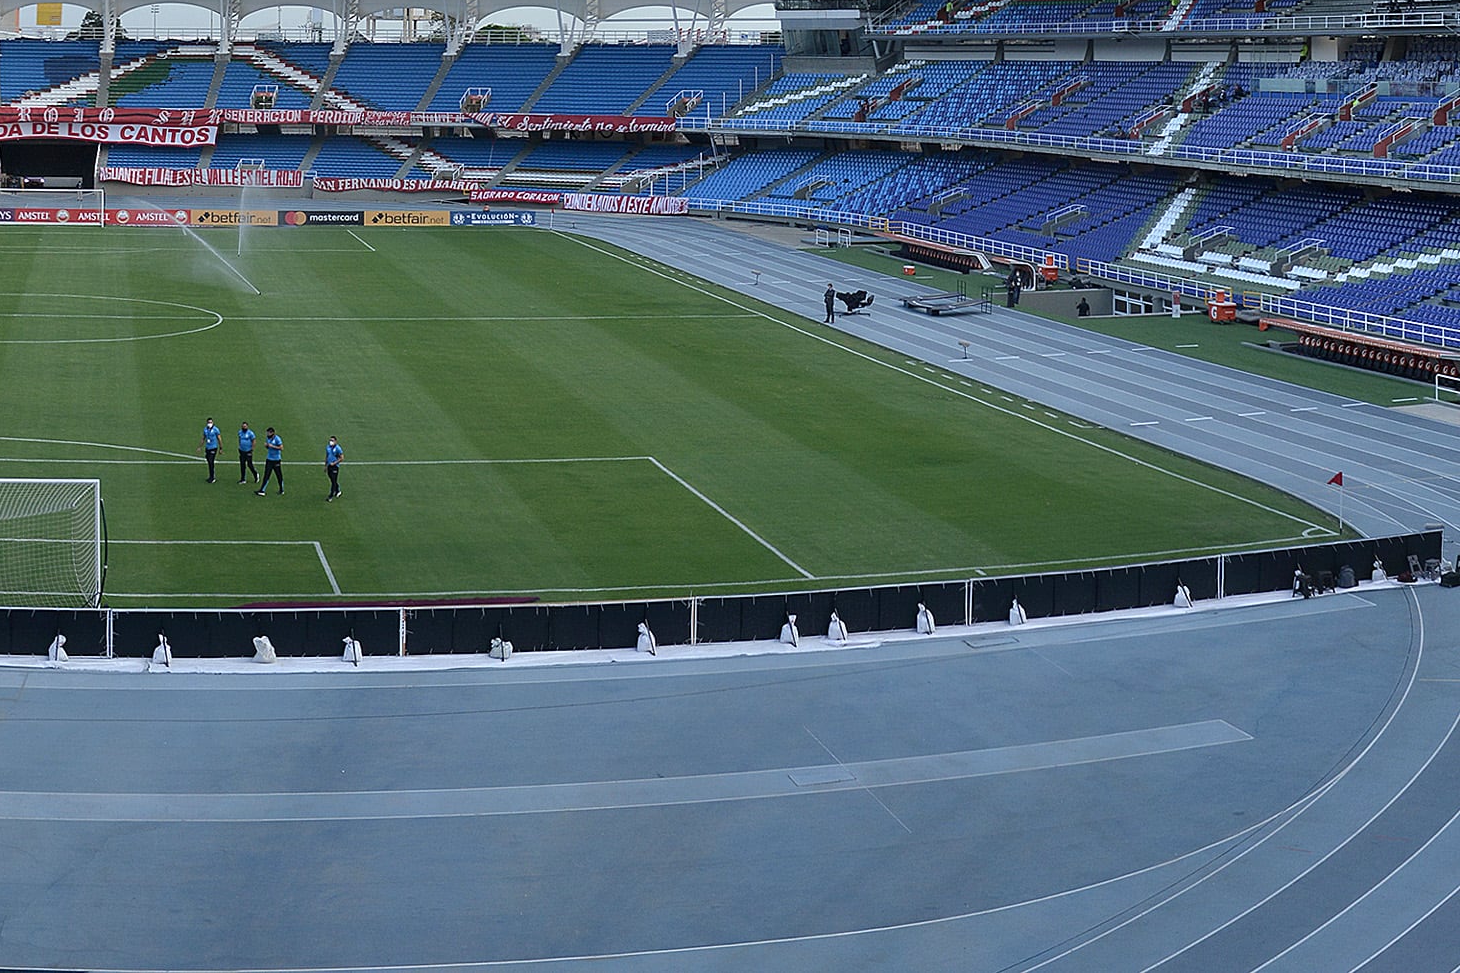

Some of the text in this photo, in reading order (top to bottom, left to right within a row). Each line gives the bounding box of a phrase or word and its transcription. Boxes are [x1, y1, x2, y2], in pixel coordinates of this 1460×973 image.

[152, 109, 223, 125] SUR
[225, 109, 302, 124] GENERACION
[517, 115, 592, 132] Sentimiento
[595, 120, 614, 131] no
[32, 122, 59, 134] DE
[68, 123, 109, 139] LOS
[120, 125, 210, 144] CANTOS
[100, 167, 144, 183] AGUANTE
[207, 169, 239, 185] VALLE
[241, 170, 254, 186] ES
[255, 170, 275, 186] DEL
[276, 170, 301, 187] ROJO
[313, 178, 479, 191] SAN FERNANDO ES MI BARRIO
[470, 191, 559, 203] SAGRADO CORAZON
[18, 212, 50, 220] AMSTEL
[136, 212, 168, 221] AMSTEL
[309, 213, 359, 222] mastercard
[1211, 306, 1218, 319] G
